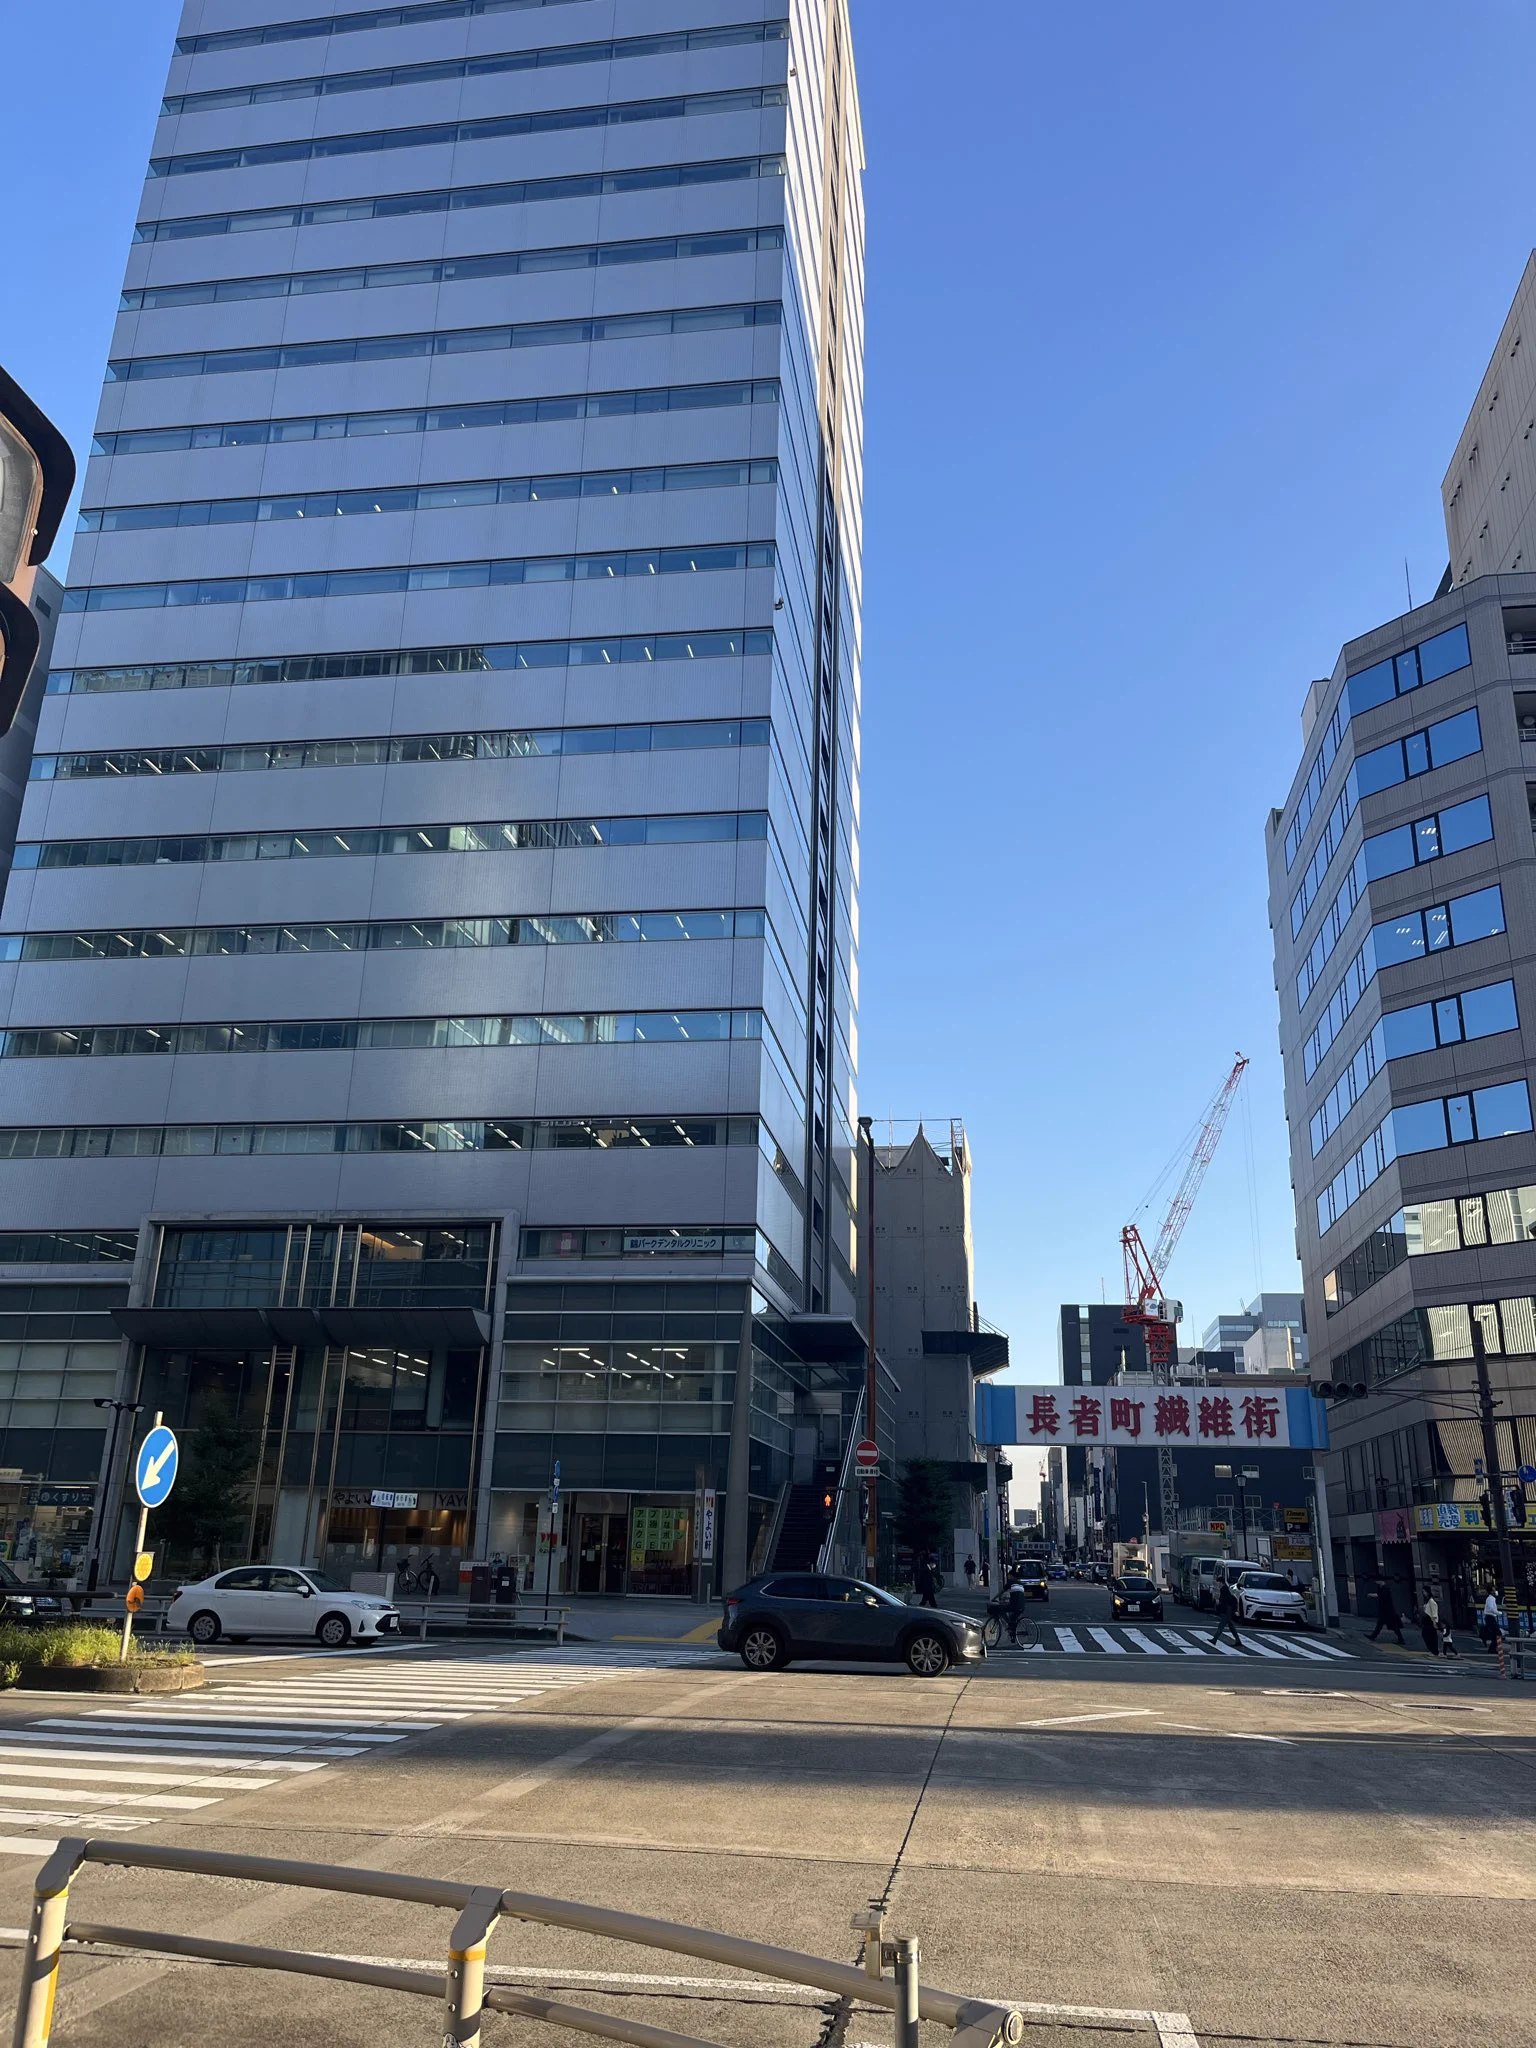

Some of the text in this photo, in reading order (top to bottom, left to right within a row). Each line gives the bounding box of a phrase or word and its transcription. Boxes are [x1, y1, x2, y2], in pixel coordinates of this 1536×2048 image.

[52, 1492, 79, 1502] くすり
[705, 1509, 713, 1551] やよい軒
